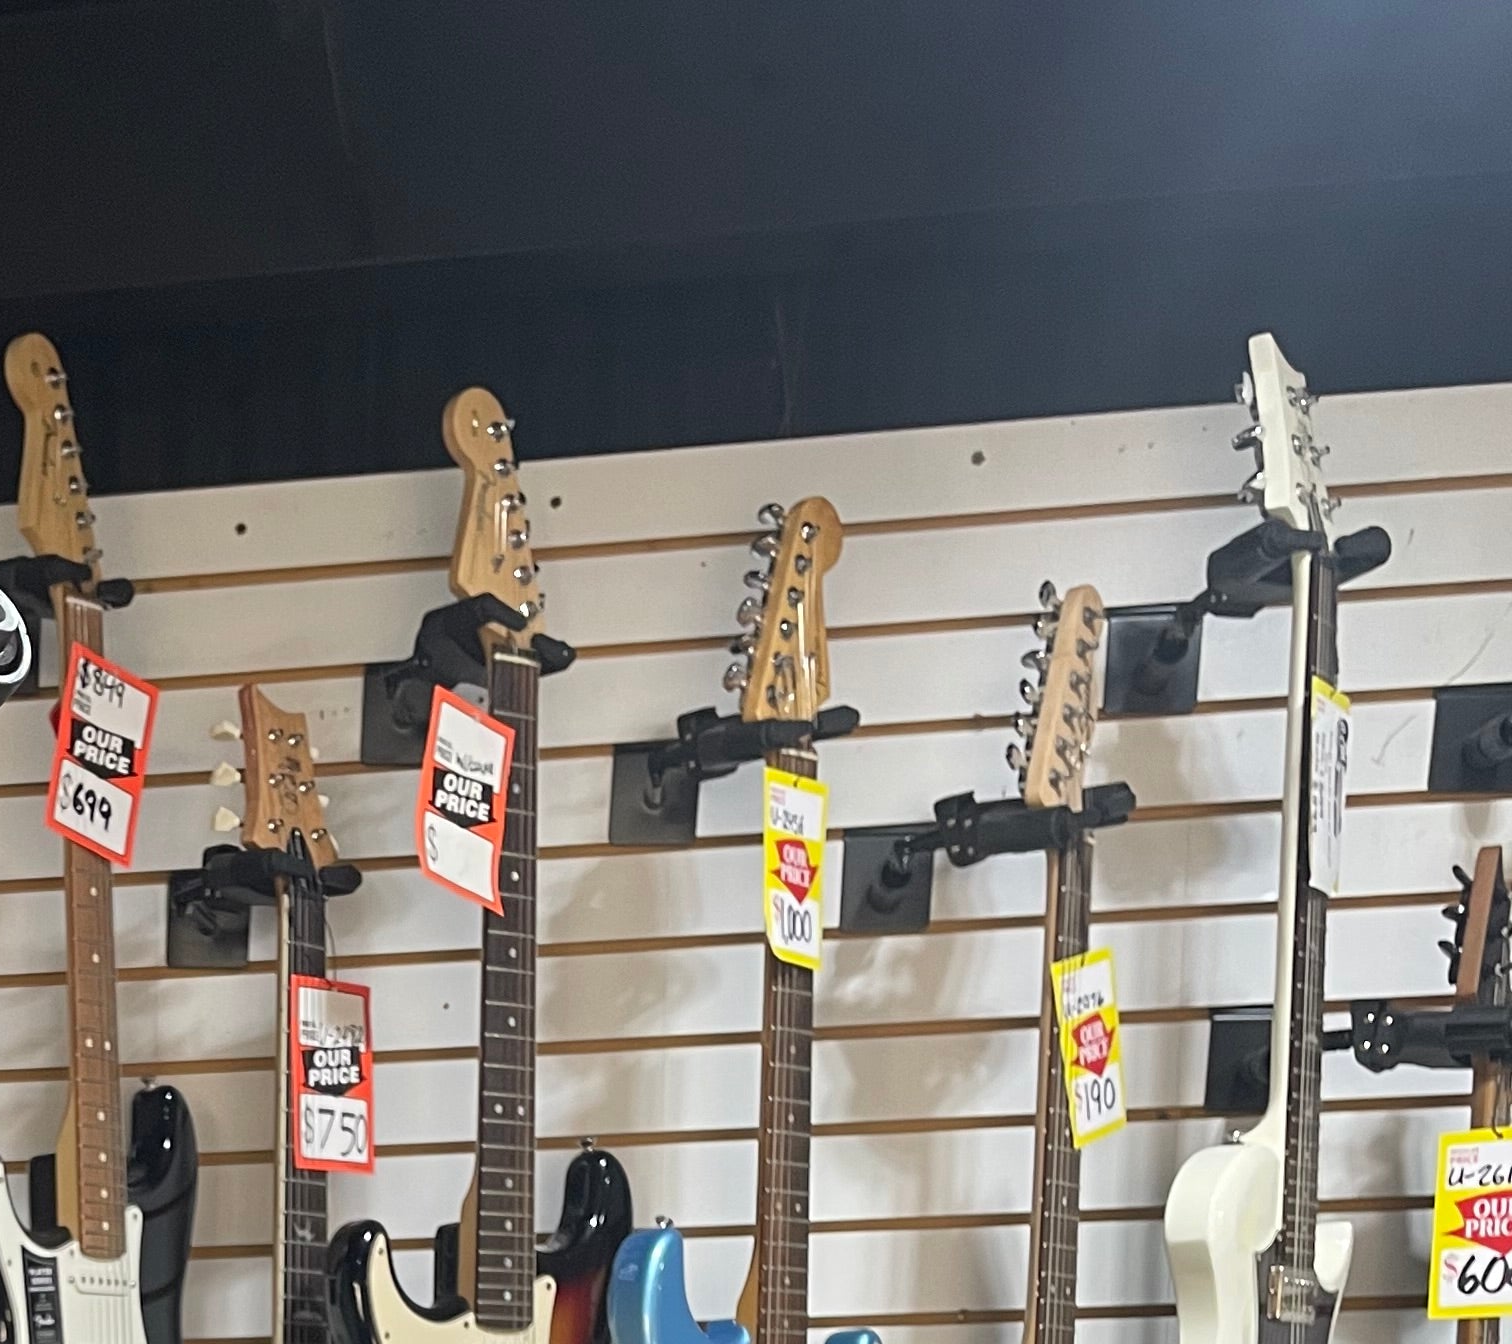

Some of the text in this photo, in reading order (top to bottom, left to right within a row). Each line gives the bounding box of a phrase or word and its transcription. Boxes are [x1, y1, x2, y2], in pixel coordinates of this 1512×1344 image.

[81, 725, 124, 754] OUR
[72, 739, 131, 775] PRICE
[59, 772, 112, 832] $699
[442, 773, 484, 801] OUR
[434, 788, 491, 822] PRICE
[313, 1049, 352, 1069] OUR
[308, 1067, 360, 1087] PRICE
[304, 1103, 368, 1157] $750
